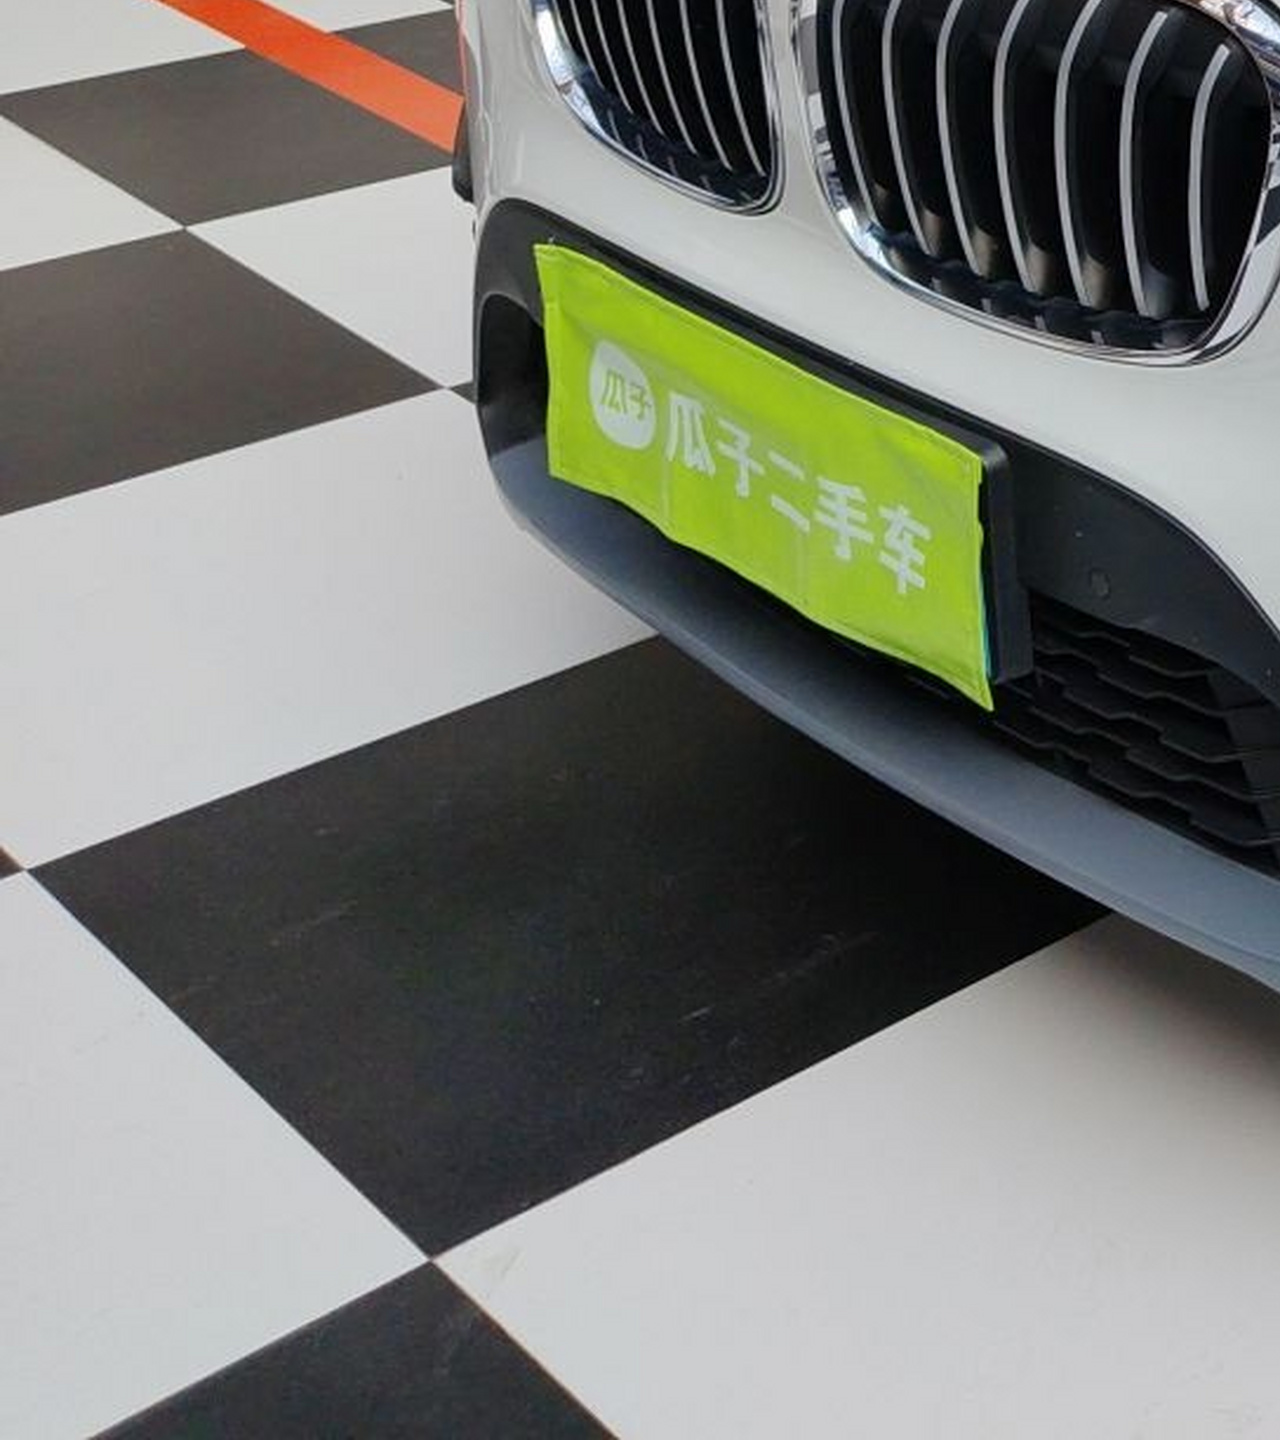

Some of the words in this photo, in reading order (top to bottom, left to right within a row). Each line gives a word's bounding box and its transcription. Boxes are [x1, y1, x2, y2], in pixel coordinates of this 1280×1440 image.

[601, 369, 653, 422] 瓜子
[664, 390, 933, 596] 瓜子二手车
